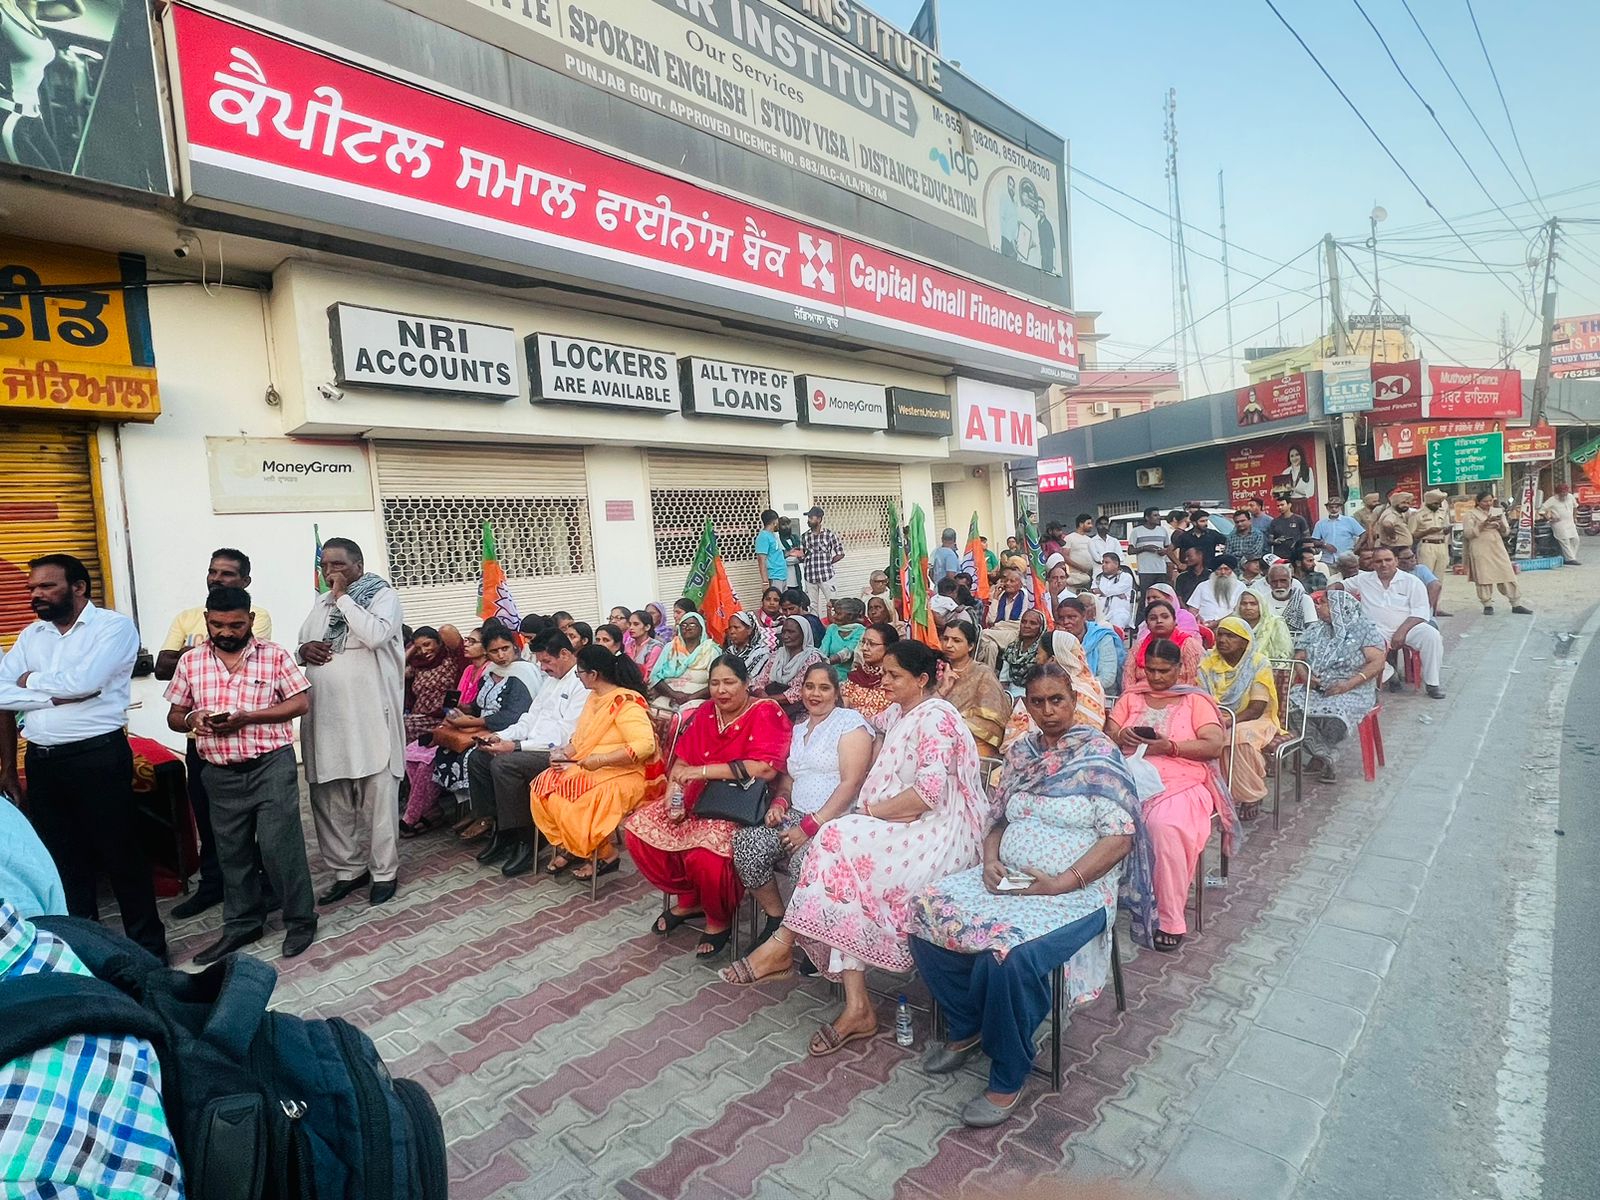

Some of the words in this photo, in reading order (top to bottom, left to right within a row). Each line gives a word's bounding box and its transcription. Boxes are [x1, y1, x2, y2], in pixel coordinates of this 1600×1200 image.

[731, 0, 911, 130] INSTITUTE
[802, 0, 943, 93] NSTITUTE
[686, 30, 725, 64] Our
[732, 53, 804, 104] Services
[565, 53, 626, 92] PUNJAB
[630, 82, 666, 110] GOVT.
[670, 100, 731, 137] APPROVED
[734, 126, 777, 158] LICENCE
[780, 147, 798, 166] NO.
[568, 4, 661, 77] SPOKEN
[664, 50, 747, 117] ENGLISH
[761, 97, 811, 146] STUDY
[813, 122, 850, 162] VISA
[859, 144, 921, 195] DISTANCE
[922, 175, 978, 219] EDUCATION
[932, 105, 944, 124] M:
[208, 47, 445, 179] ਕੈਪੀਟਲ
[455, 146, 586, 220] ਸਮਾਲ
[595, 188, 734, 263] ਫਾਈਨਾਂਸ
[742, 216, 790, 278] ਬੈਂਕ
[947, 137, 979, 186] idp
[850, 253, 917, 303] Capital
[921, 277, 966, 318] Small
[970, 293, 1023, 335] Finance
[1026, 314, 1056, 345] Bank
[397, 320, 469, 354] NRI
[355, 348, 512, 386] ACCOUNTS
[551, 340, 668, 381] LOCKERS
[700, 363, 728, 382] ALL
[731, 367, 767, 387] TYPE
[771, 373, 788, 390] OF
[1552, 354, 1579, 365] STUDY
[554, 375, 586, 394] ARE
[592, 380, 671, 403] AVAILABLE
[712, 387, 782, 413] LOANS
[828, 396, 883, 414] MoneyGram
[1325, 382, 1371, 397] IELTS
[965, 404, 1034, 447] ATM
[262, 460, 352, 476] MoneyGram
[1040, 475, 1068, 488] ATM
